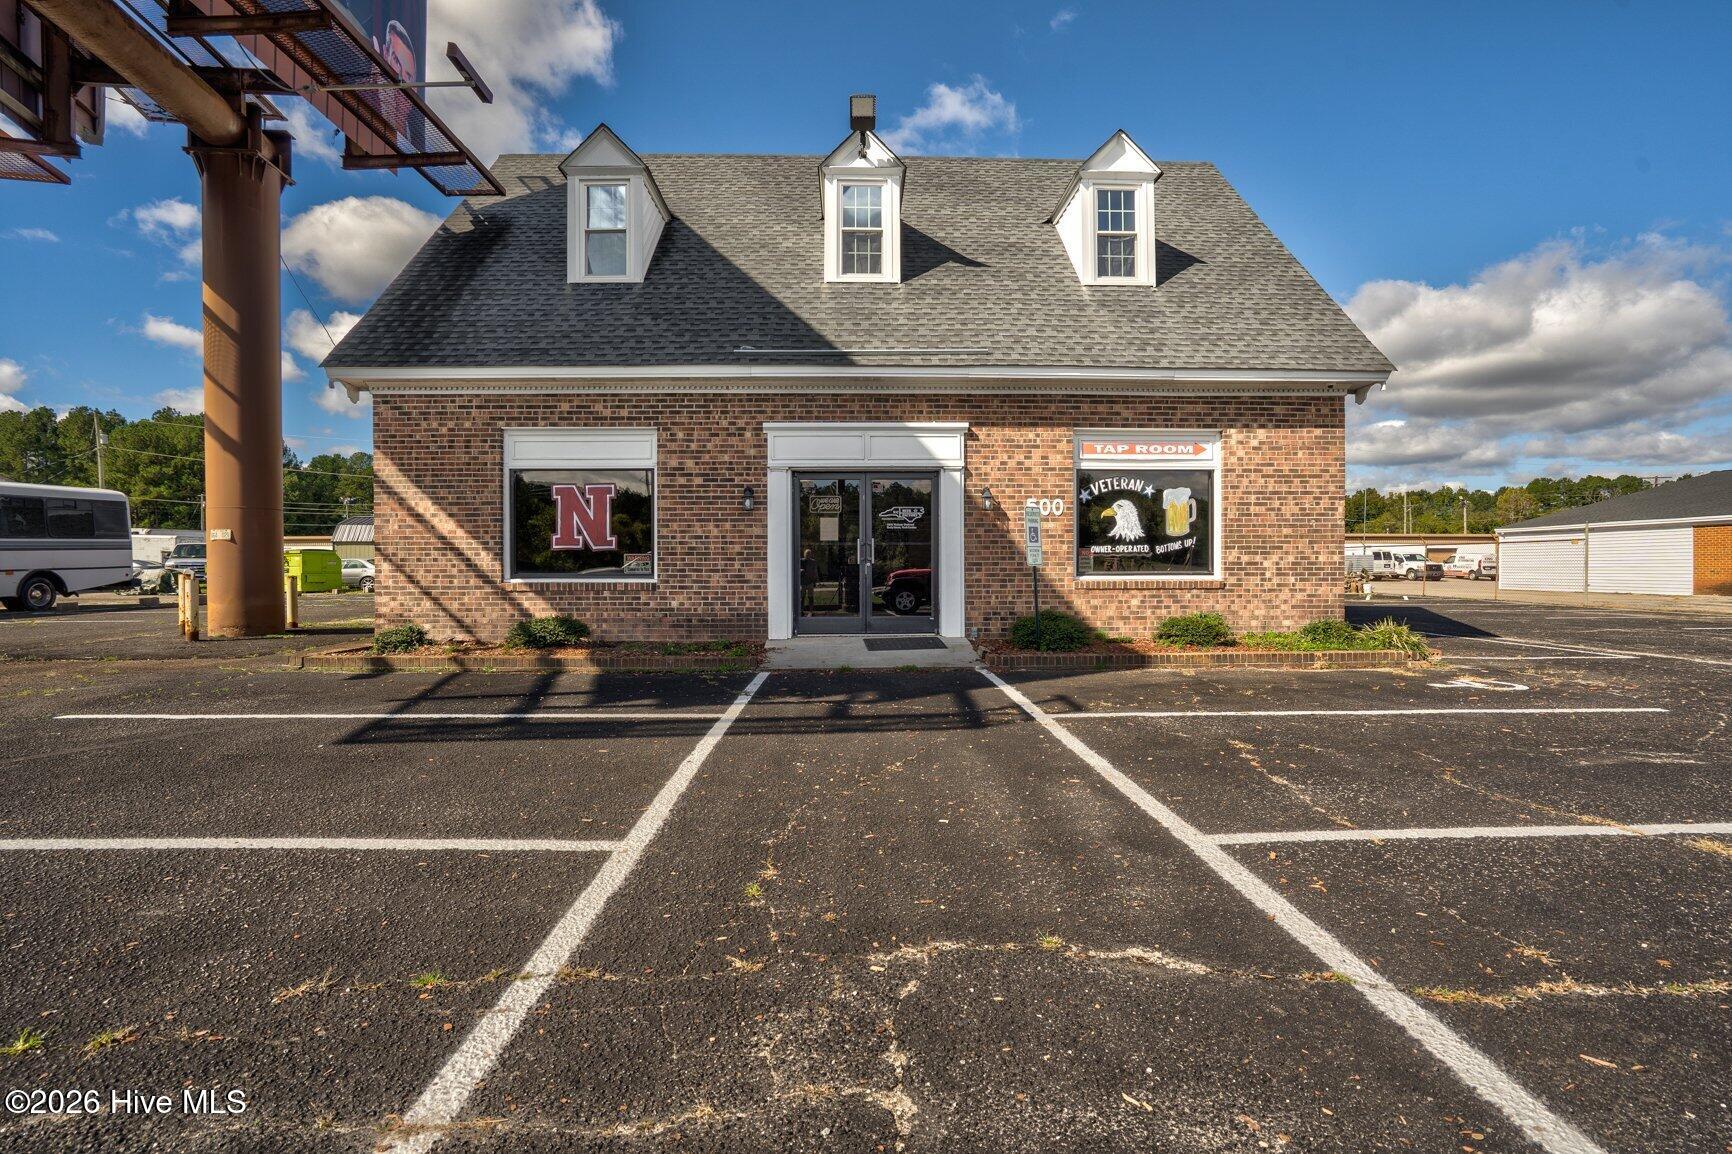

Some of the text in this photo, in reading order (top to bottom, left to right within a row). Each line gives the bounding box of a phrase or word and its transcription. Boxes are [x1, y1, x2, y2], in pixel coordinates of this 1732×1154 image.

[1094, 445, 1194, 454] TAP ROOM
[1090, 476, 1145, 496] VETERAN
[551, 483, 617, 552] N
[1090, 545, 1150, 554] OWNER-OPERATED
[1156, 536, 1197, 554] BOTTOMS UP!
